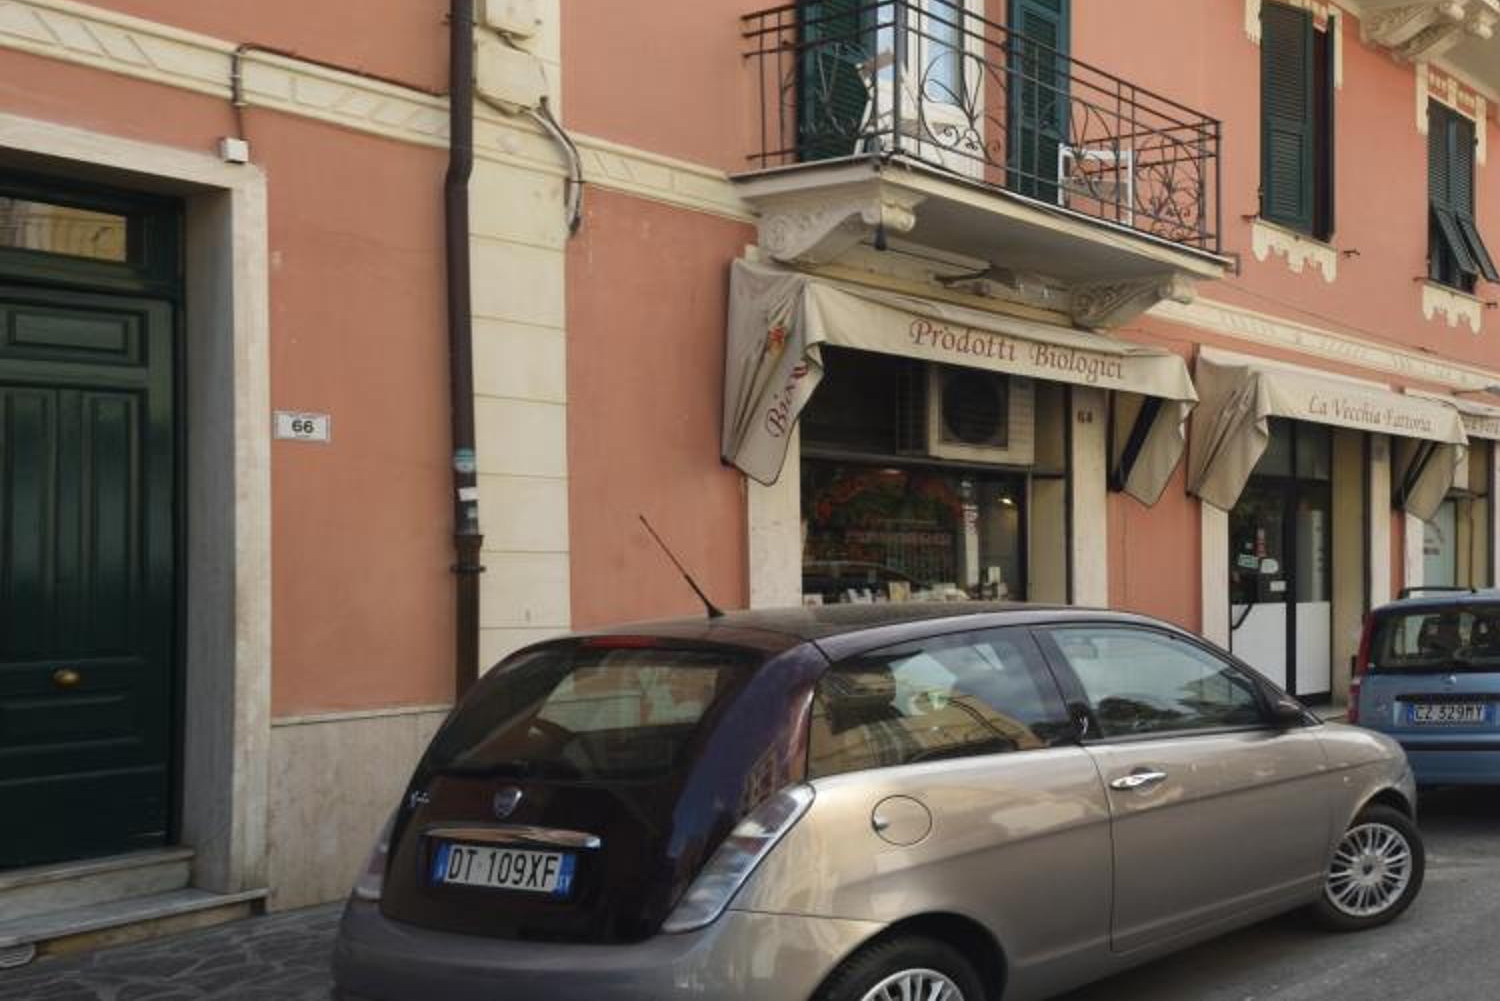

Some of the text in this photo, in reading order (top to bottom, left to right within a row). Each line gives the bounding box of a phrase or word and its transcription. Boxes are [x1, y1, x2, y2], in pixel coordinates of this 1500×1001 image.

[909, 318, 1122, 383] Prodotti Biologici
[291, 419, 315, 434] 66
[449, 848, 479, 881] DT
[487, 852, 559, 889] 109XF
